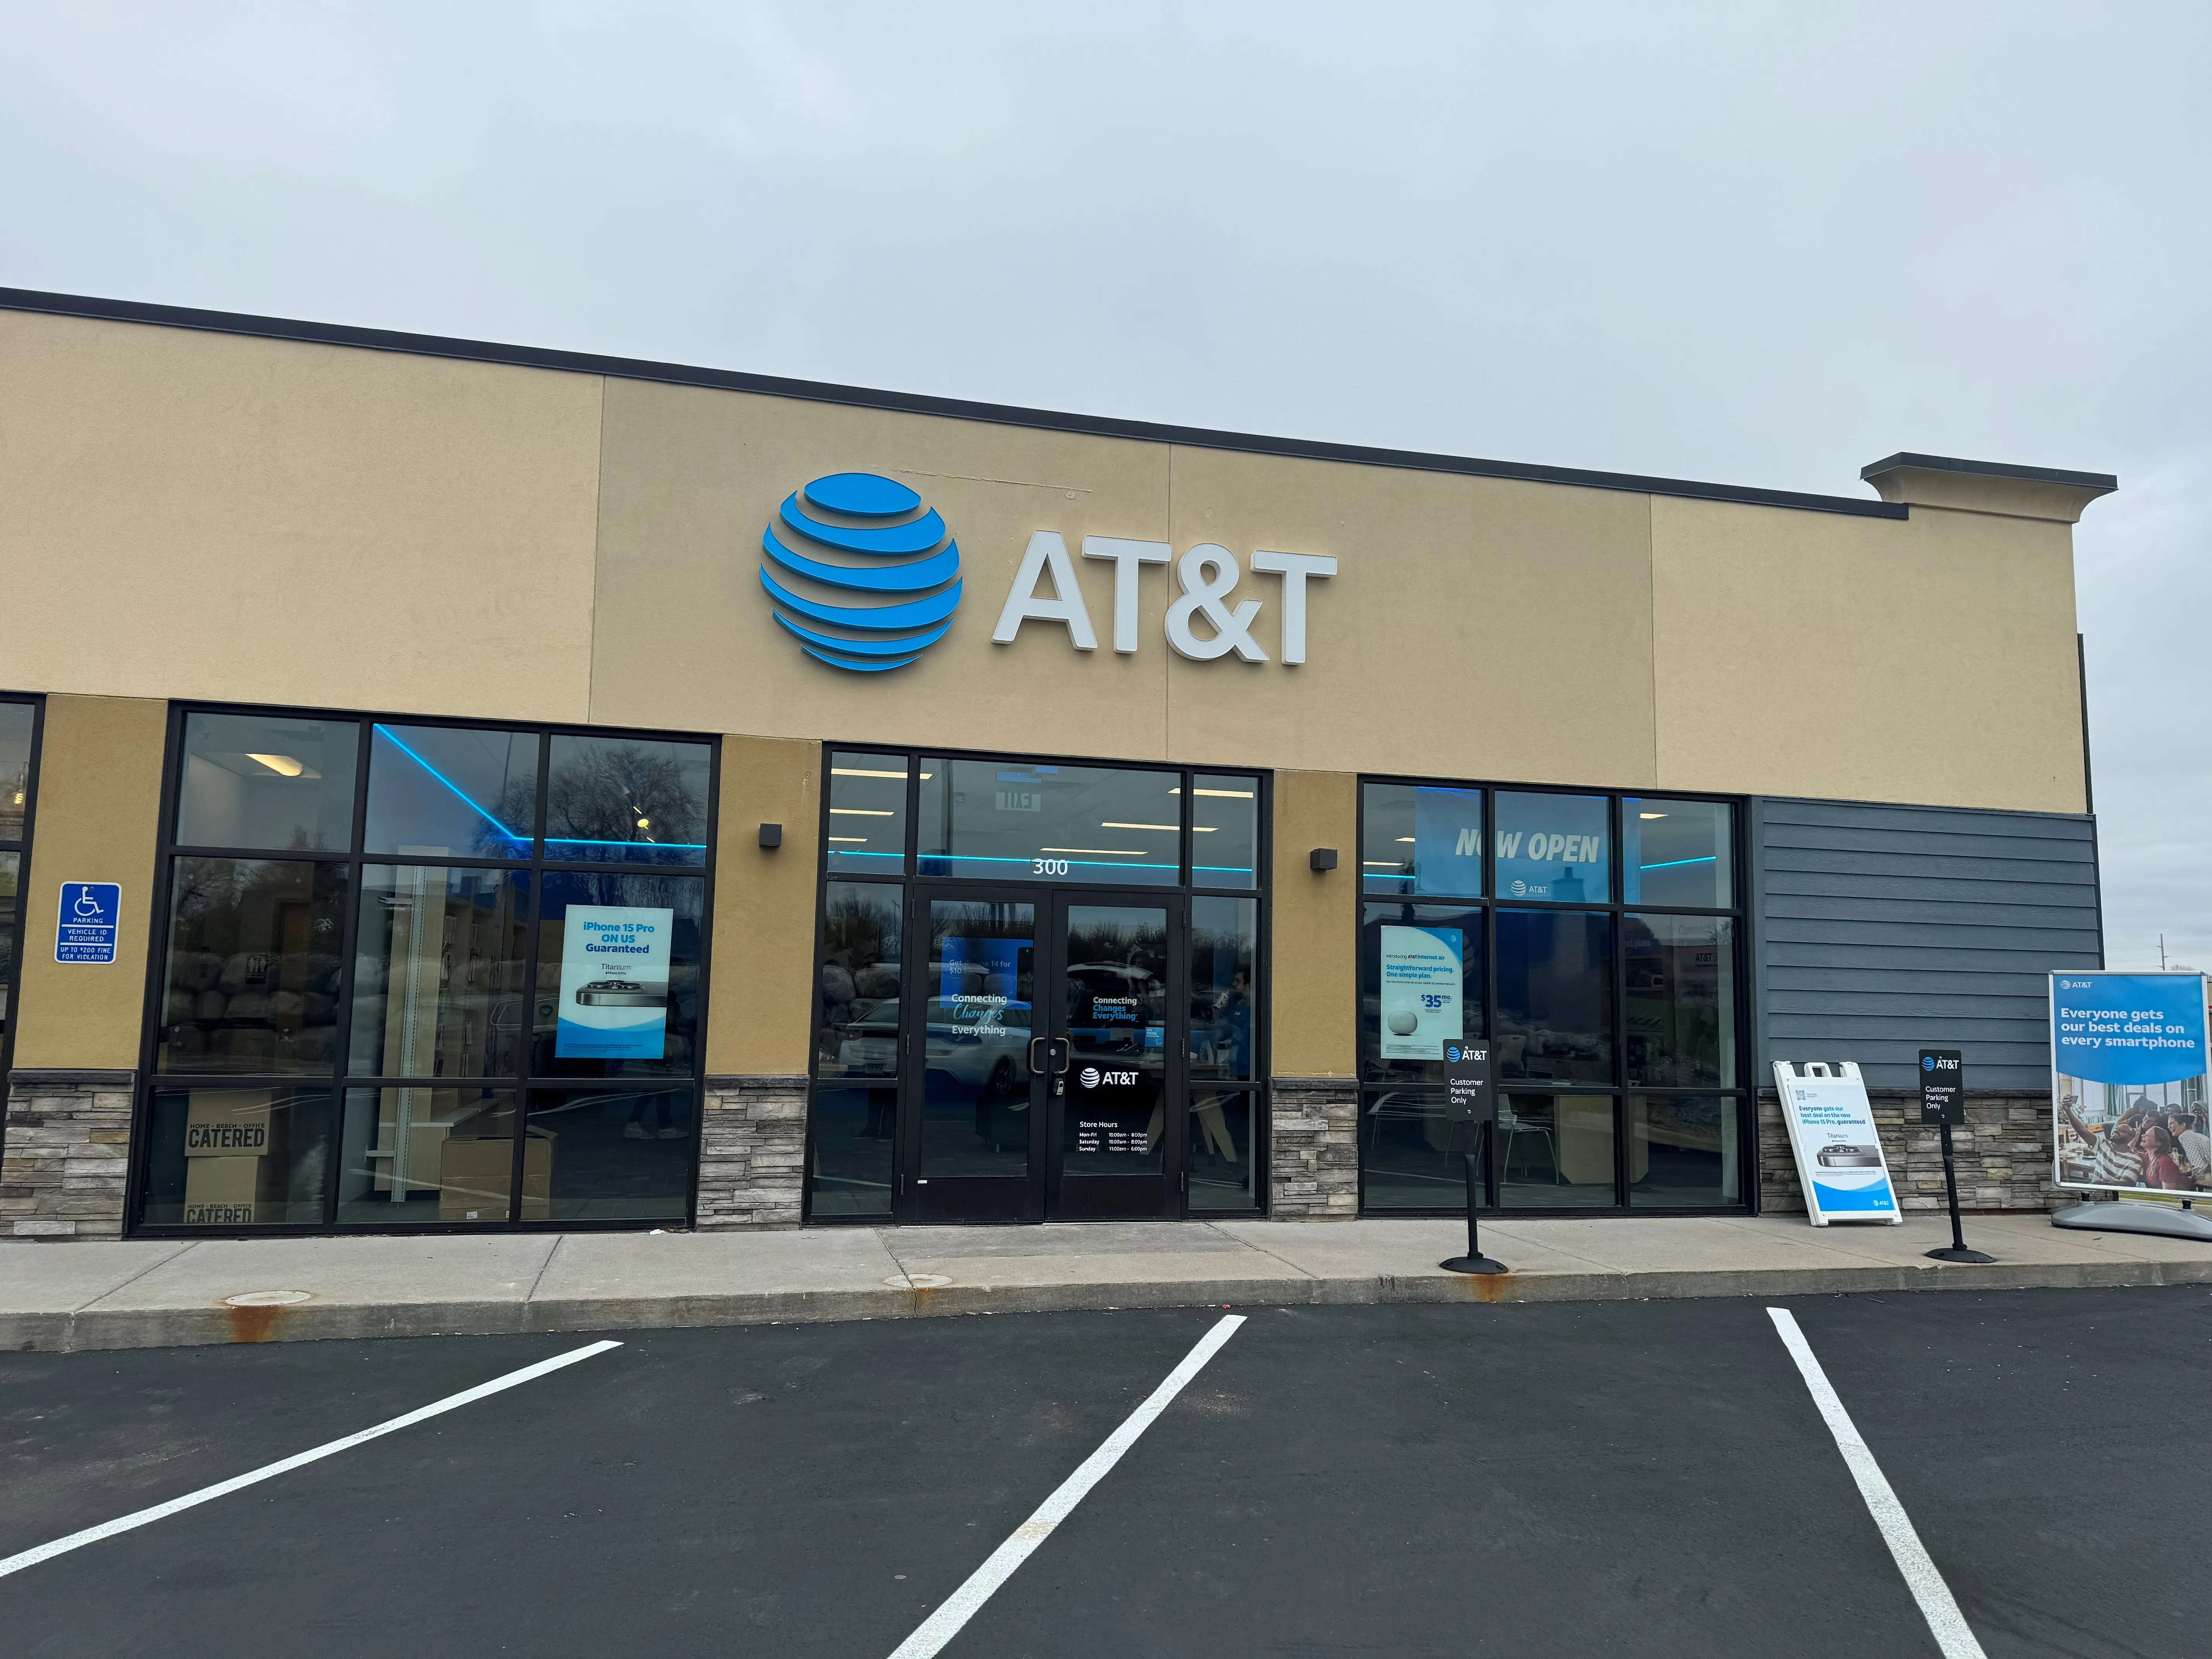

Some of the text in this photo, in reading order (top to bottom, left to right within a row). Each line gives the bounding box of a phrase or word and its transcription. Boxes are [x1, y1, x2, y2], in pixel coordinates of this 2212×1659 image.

[991, 529, 1338, 665] AT&T
[1528, 833, 1599, 863] OPEN
[1033, 858, 1068, 875] 300
[584, 922, 654, 933] iPhone 15 Pro
[601, 934, 635, 943] ON US
[586, 943, 649, 953] Guaranteed
[951, 994, 1007, 1005] Connecting
[1093, 997, 1137, 1006] Connecting
[1421, 994, 1441, 1008] $35
[953, 1003, 1004, 1024] Changes
[1093, 1004, 1126, 1013] Changes
[2061, 1008, 2164, 1022] Everyone gets
[952, 1025, 1006, 1036] Everything
[2061, 1021, 2184, 1034] our best deals on
[2062, 1036, 2195, 1049] every smartphone
[1462, 1050, 1487, 1060] AT&T
[1936, 1060, 1959, 1069] AT&T
[1102, 1072, 1139, 1085] AT&T
[1451, 1087, 1475, 1096] Parking
[1451, 1097, 1467, 1105] Only
[189, 1128, 264, 1148] CATERED
[187, 1208, 252, 1223] CATERED
